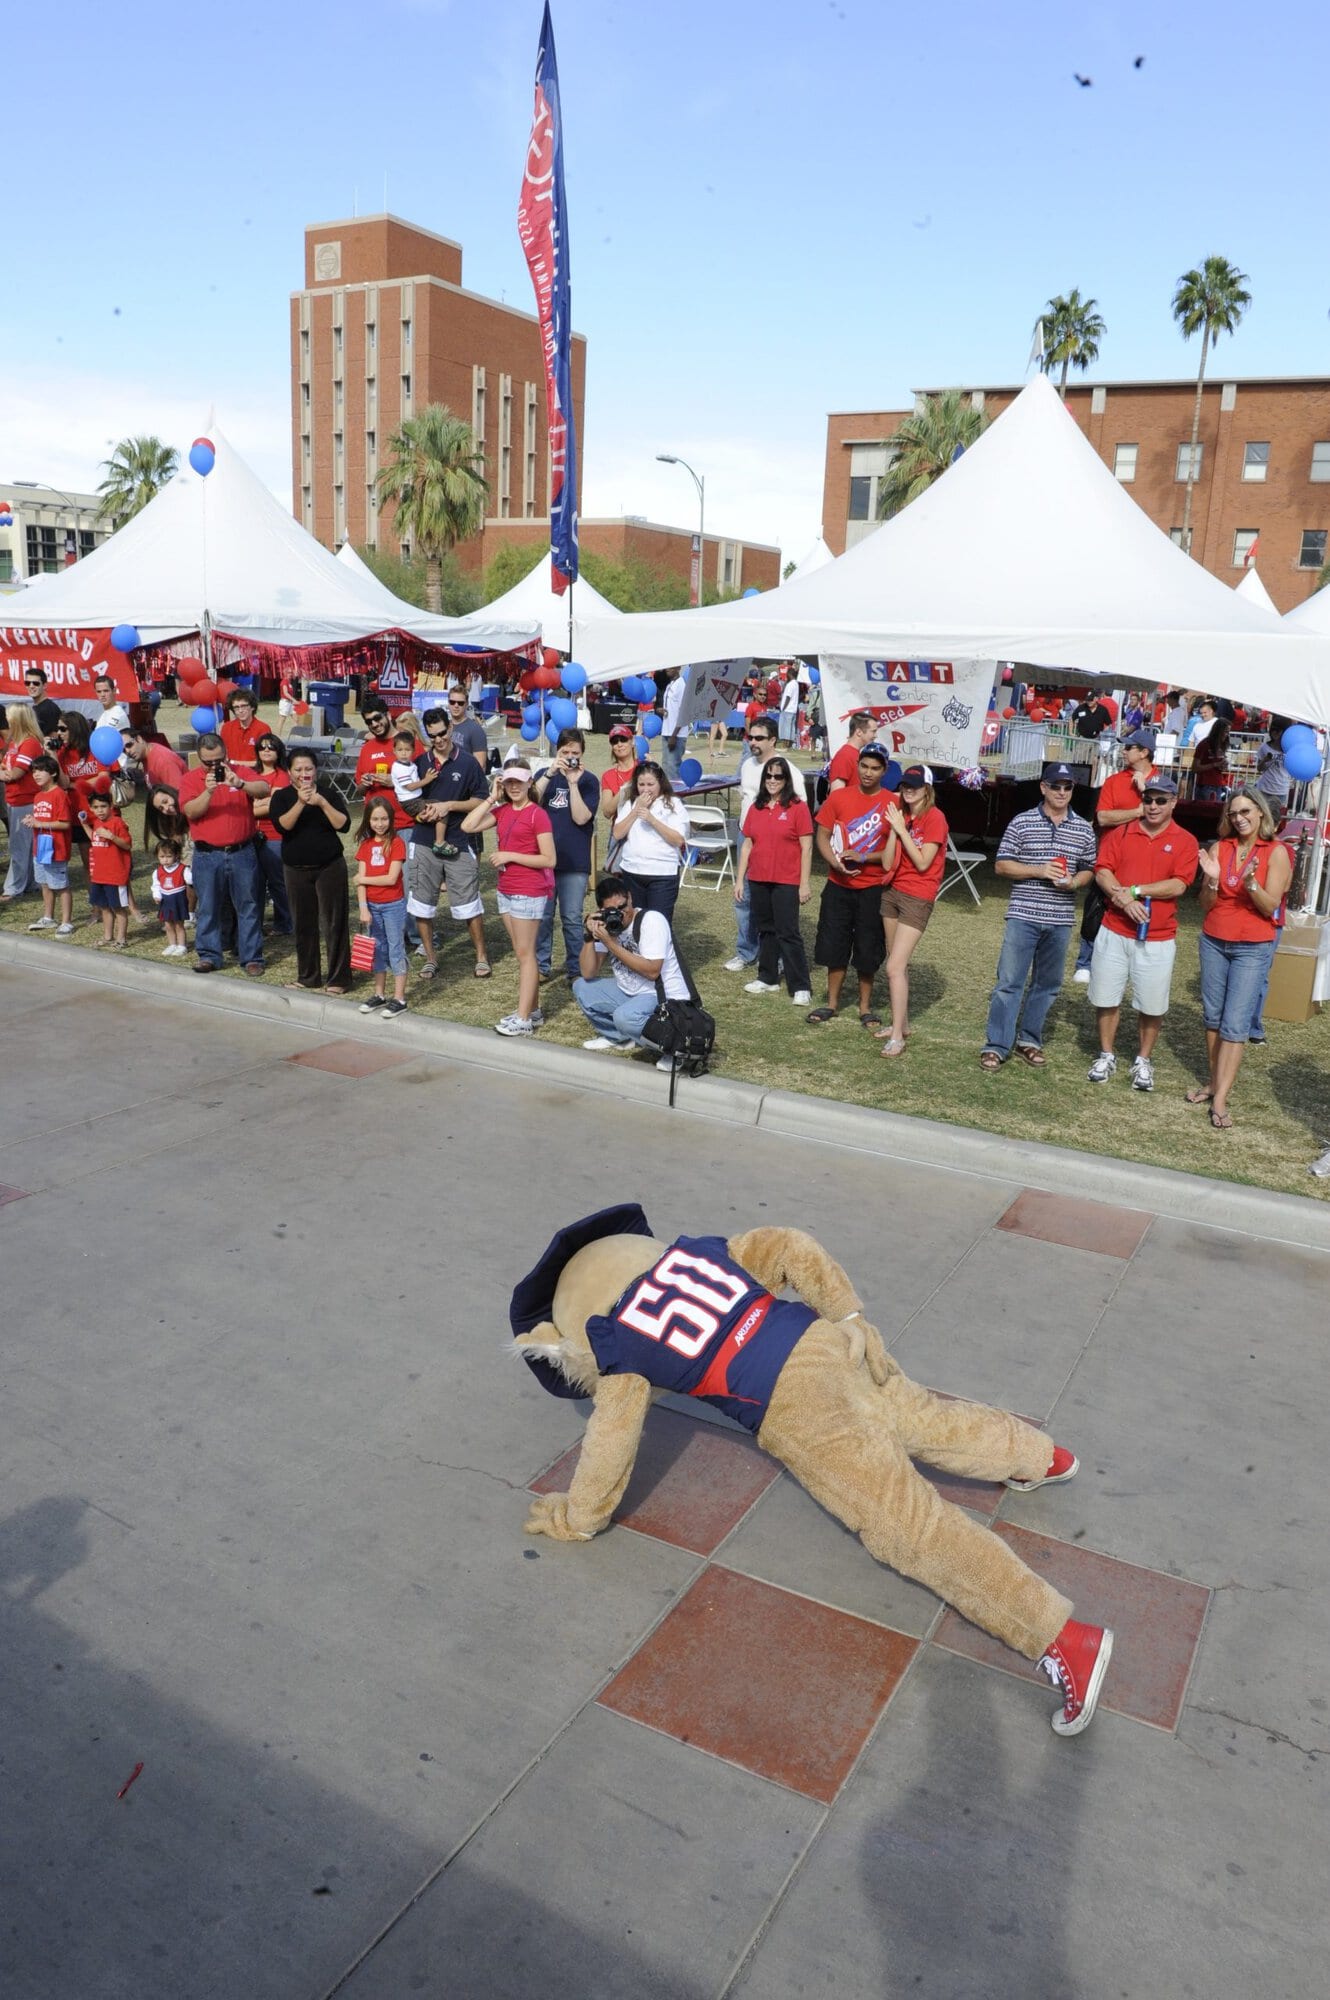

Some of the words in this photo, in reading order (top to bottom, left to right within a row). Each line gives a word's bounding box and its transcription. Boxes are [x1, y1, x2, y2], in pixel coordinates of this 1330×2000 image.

[870, 661, 949, 682] SALT
[886, 684, 937, 703] Center
[877, 706, 905, 725] ged
[921, 715, 941, 735] to
[549, 788, 569, 809] A
[856, 813, 880, 836] ZOO
[619, 1249, 750, 1360] 50
[734, 1308, 763, 1347] ARIZONA
